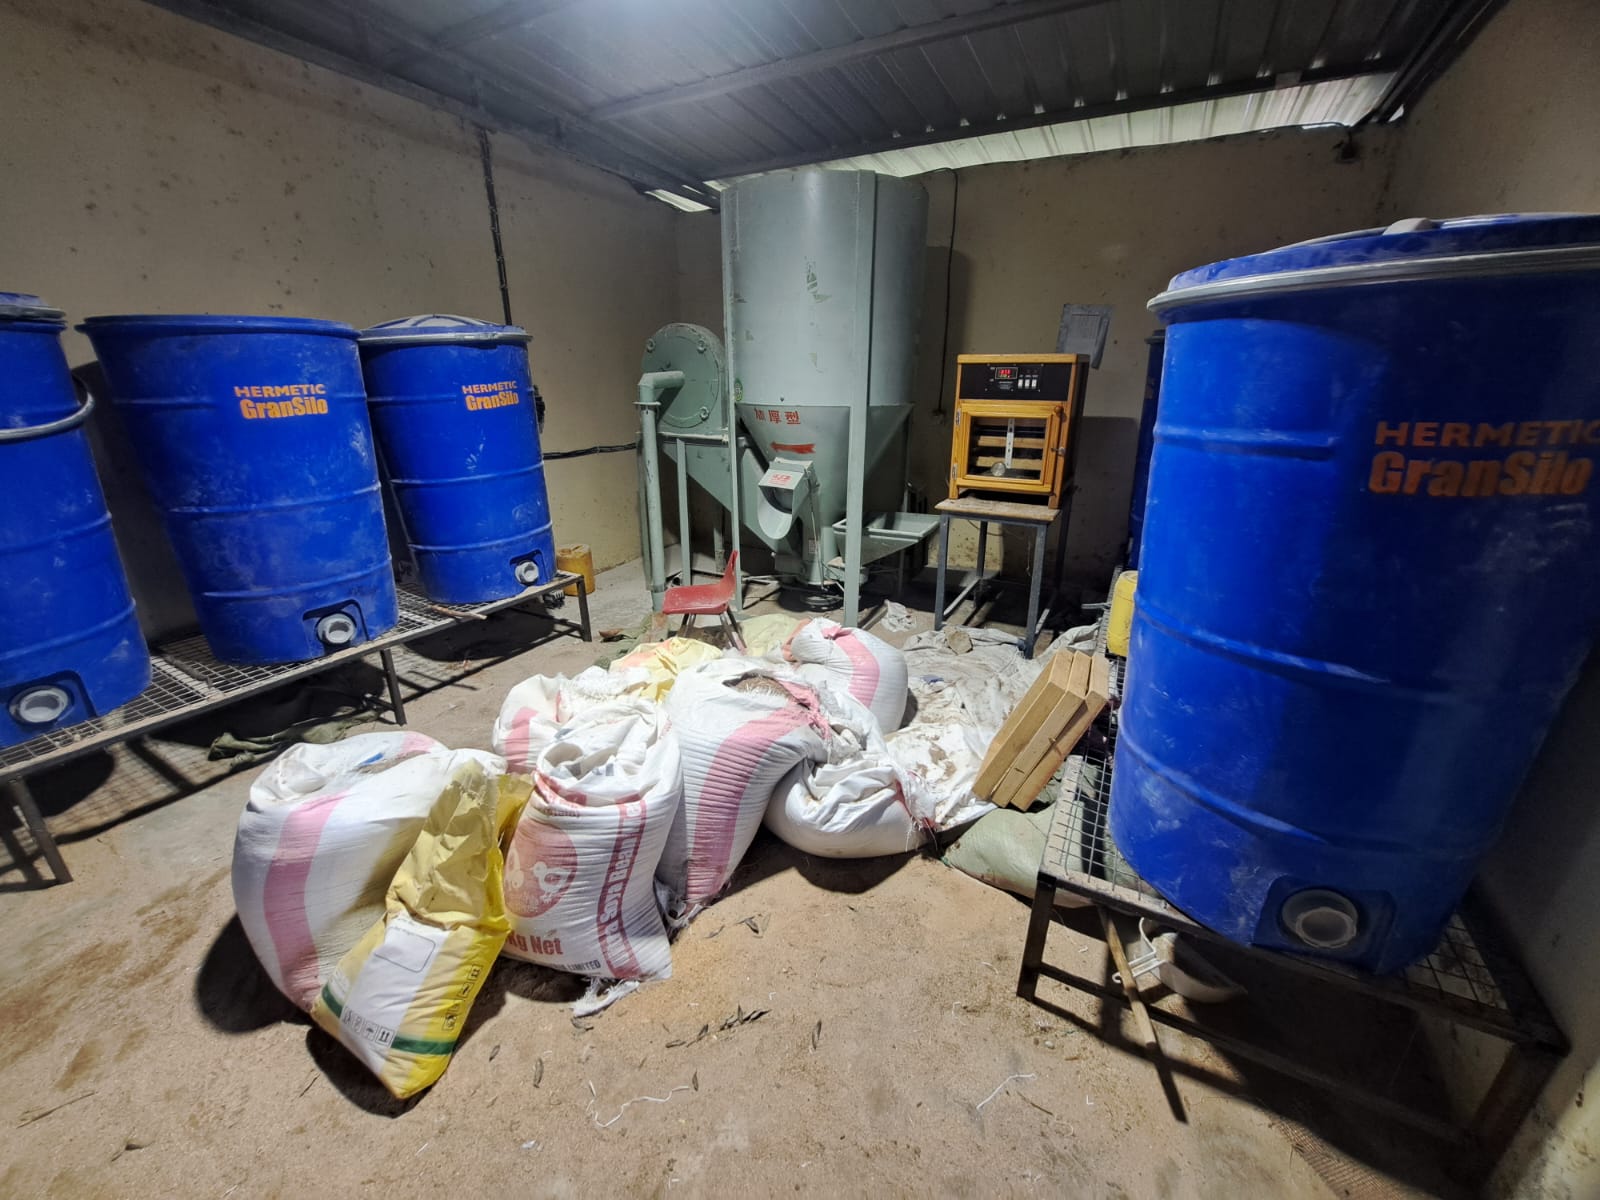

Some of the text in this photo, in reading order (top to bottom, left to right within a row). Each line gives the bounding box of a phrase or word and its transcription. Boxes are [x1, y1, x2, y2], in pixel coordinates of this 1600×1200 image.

[233, 384, 327, 398] HERMETIC
[462, 381, 518, 395] HERMETIC
[240, 396, 329, 419] GranSilo
[465, 391, 519, 411] GranSilo
[1368, 451, 1593, 497] GranSilo
[610, 838, 636, 882] Bean
[530, 935, 563, 955] Net
